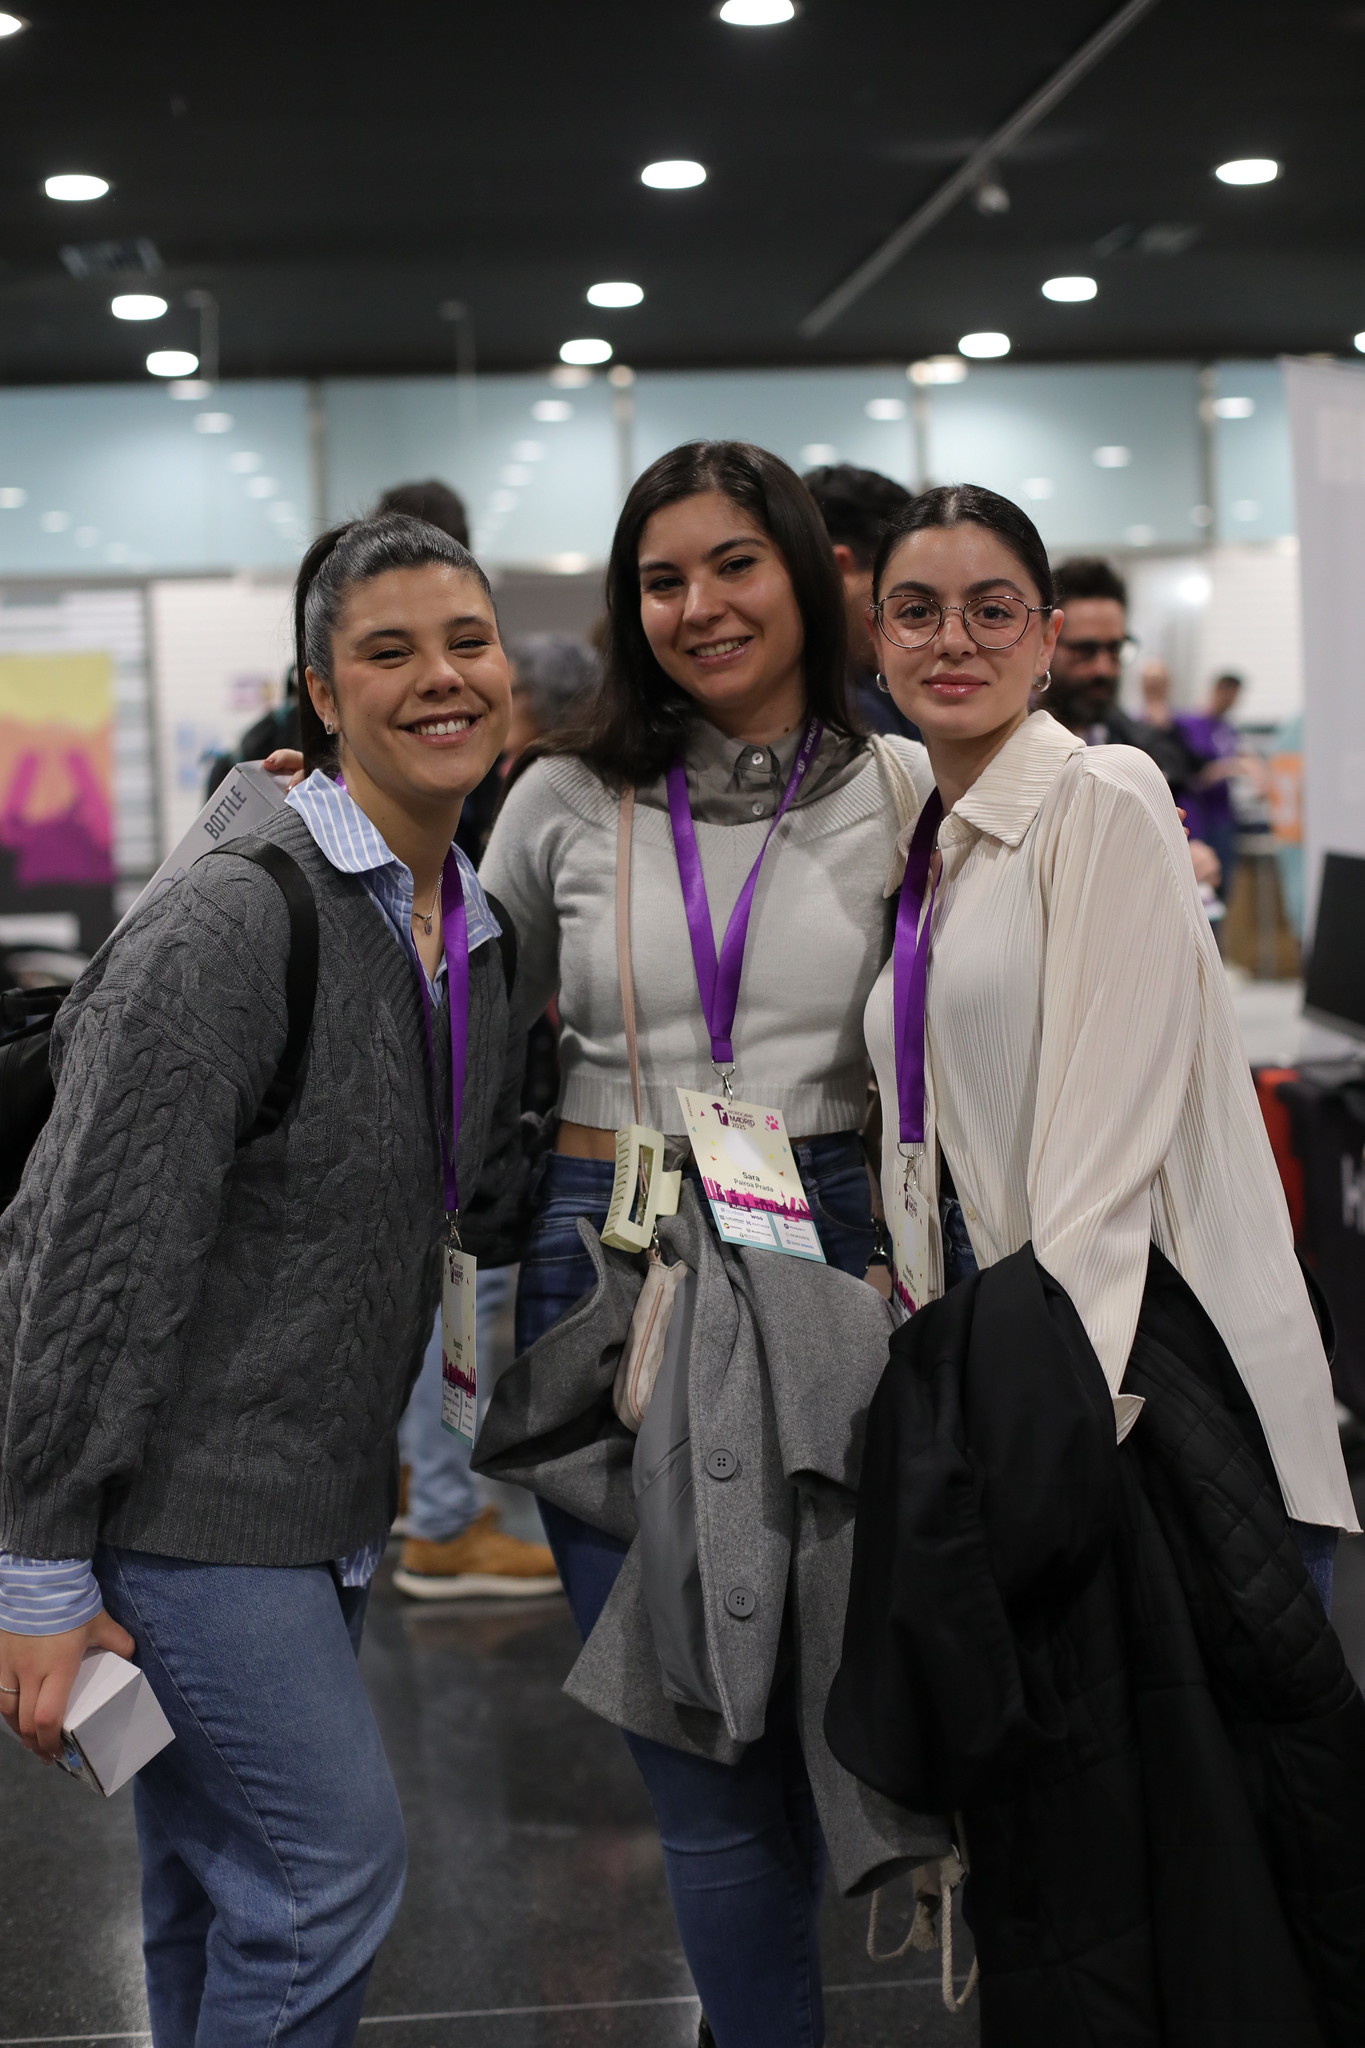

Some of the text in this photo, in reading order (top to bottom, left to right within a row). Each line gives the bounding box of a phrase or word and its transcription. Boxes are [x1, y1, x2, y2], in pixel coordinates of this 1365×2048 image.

[203, 785, 247, 841] BOTTLE
[729, 1115, 756, 1128] MADRID
[731, 1122, 747, 1131] 2025
[742, 1171, 761, 1182] Sara
[754, 1182, 774, 1193] Prada
